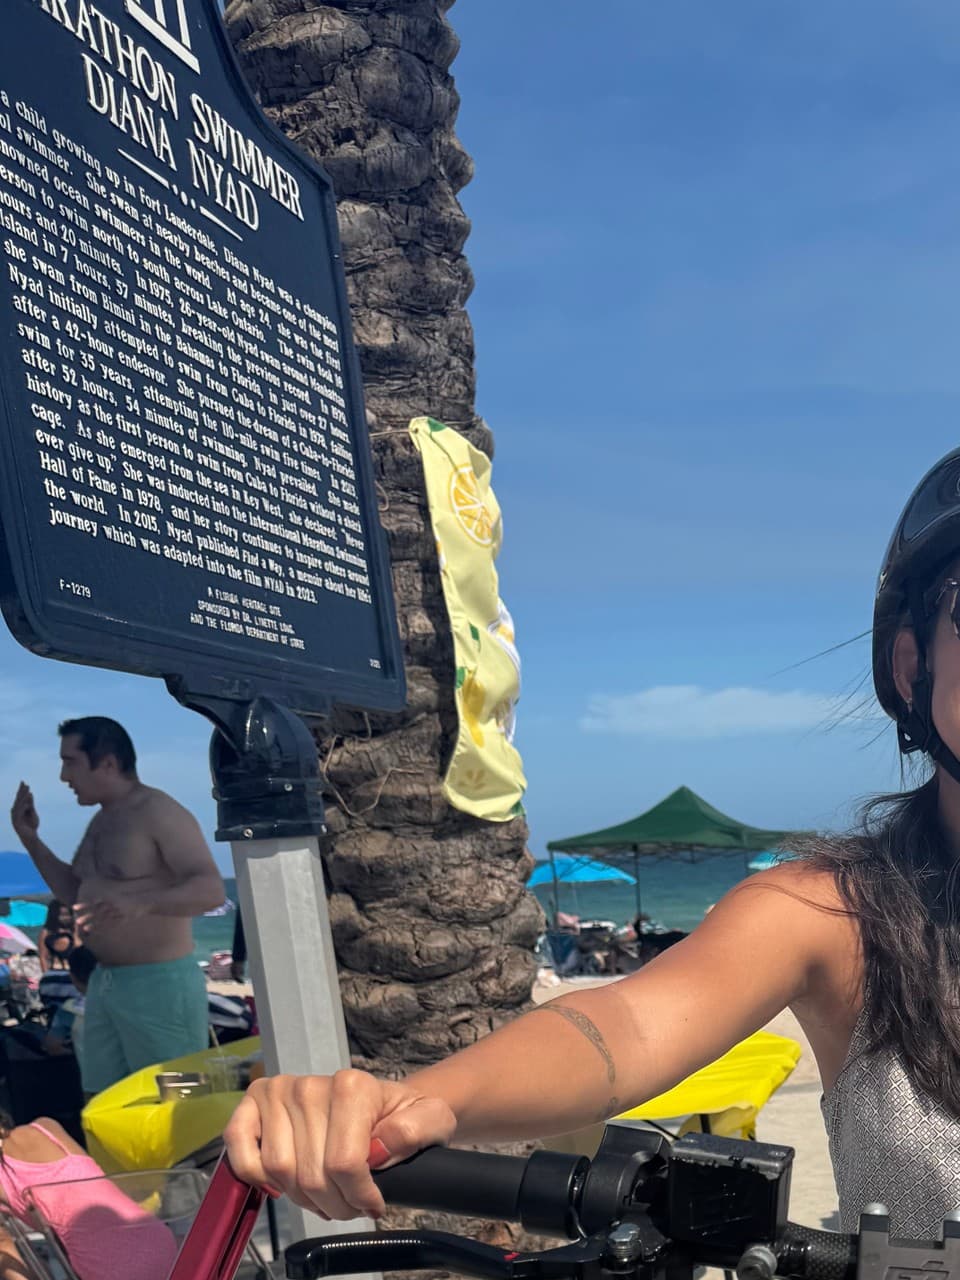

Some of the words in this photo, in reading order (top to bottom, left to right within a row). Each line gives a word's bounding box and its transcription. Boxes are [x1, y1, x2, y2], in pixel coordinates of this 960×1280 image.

[15, 101, 47, 134] child
[52, 128, 102, 177] growing
[104, 165, 120, 188] up
[123, 175, 136, 198] in
[138, 186, 161, 215] Fort
[16, 126, 73, 175] swimmer.
[85, 171, 107, 198] She
[109, 192, 139, 221] swam
[141, 213, 153, 230] at
[81, 52, 177, 171] DIANA
[186, 138, 259, 231] NYAD
[190, 93, 304, 221] SWIMMER
[35, 211, 58, 236] and
[60, 223, 76, 247] 20
[78, 238, 124, 276] minutes.
[134, 269, 148, 291] In
[148, 278, 174, 308] 1975,
[40, 187, 54, 209] to
[58, 203, 89, 232] swim
[91, 224, 124, 255] north
[126, 243, 140, 264] to
[142, 257, 170, 284] south
[53, 176, 90, 210] ocean
[94, 203, 146, 247] swimmers
[148, 235, 161, 257] in
[163, 246, 181, 269] the
[3, 238, 27, 263] she
[31, 255, 65, 285] swam
[69, 274, 98, 304] from
[100, 292, 136, 326] Bimini
[139, 314, 152, 335] in
[154, 323, 172, 345] the
[8, 262, 44, 298] Nyad
[48, 285, 98, 329] initially
[104, 320, 159, 360] attempted
[162, 349, 174, 368] to
[177, 361, 202, 383] swim
[42, 233, 57, 257] in
[60, 244, 68, 263] 7
[73, 253, 111, 290] hours,
[115, 278, 128, 299] 57
[133, 293, 176, 328] minutes,
[12, 295, 47, 323] after
[51, 314, 60, 331] a
[65, 320, 114, 358] 42-hour
[117, 351, 168, 386] endeavor.
[176, 378, 195, 400] She
[18, 322, 51, 350] swim
[55, 337, 75, 361] for
[79, 350, 95, 371] 35
[99, 363, 135, 392] years,
[143, 385, 199, 426] attempting
[21, 348, 56, 375] after
[61, 363, 78, 386] 52
[81, 374, 118, 406] hours,
[125, 394, 140, 416] 54
[144, 407, 184, 436] minutes
[187, 427, 198, 442] of
[26, 372, 72, 410] history
[77, 398, 91, 416] as
[93, 402, 113, 425] the
[115, 413, 142, 438] first
[144, 429, 180, 455] person
[181, 443, 194, 461] to
[30, 403, 66, 429] cage.
[76, 419, 92, 439] As
[96, 429, 116, 450] she
[120, 441, 167, 471] emerged
[169, 459, 194, 482] from
[195, 470, 212, 489] the
[35, 428, 64, 451] ever
[67, 441, 94, 463] give
[121, 460, 143, 482] She
[146, 473, 165, 492] was
[167, 478, 210, 508] inducted
[39, 450, 67, 477] Hall
[71, 466, 84, 483] of
[87, 468, 117, 495] Fame
[120, 482, 134, 502] in
[136, 488, 164, 514] 1978,
[170, 504, 190, 522] and
[192, 509, 210, 529] her
[43, 477, 66, 500] the
[70, 490, 108, 515] world.
[117, 503, 132, 523] In
[133, 510, 160, 534] 2015,
[165, 520, 193, 544] Nyad
[49, 502, 97, 537] journey
[102, 525, 137, 547] which
[139, 537, 161, 555] was
[163, 544, 204, 568] adapted
[205, 555, 226, 575] into
[60, 578, 91, 598] F-1279
